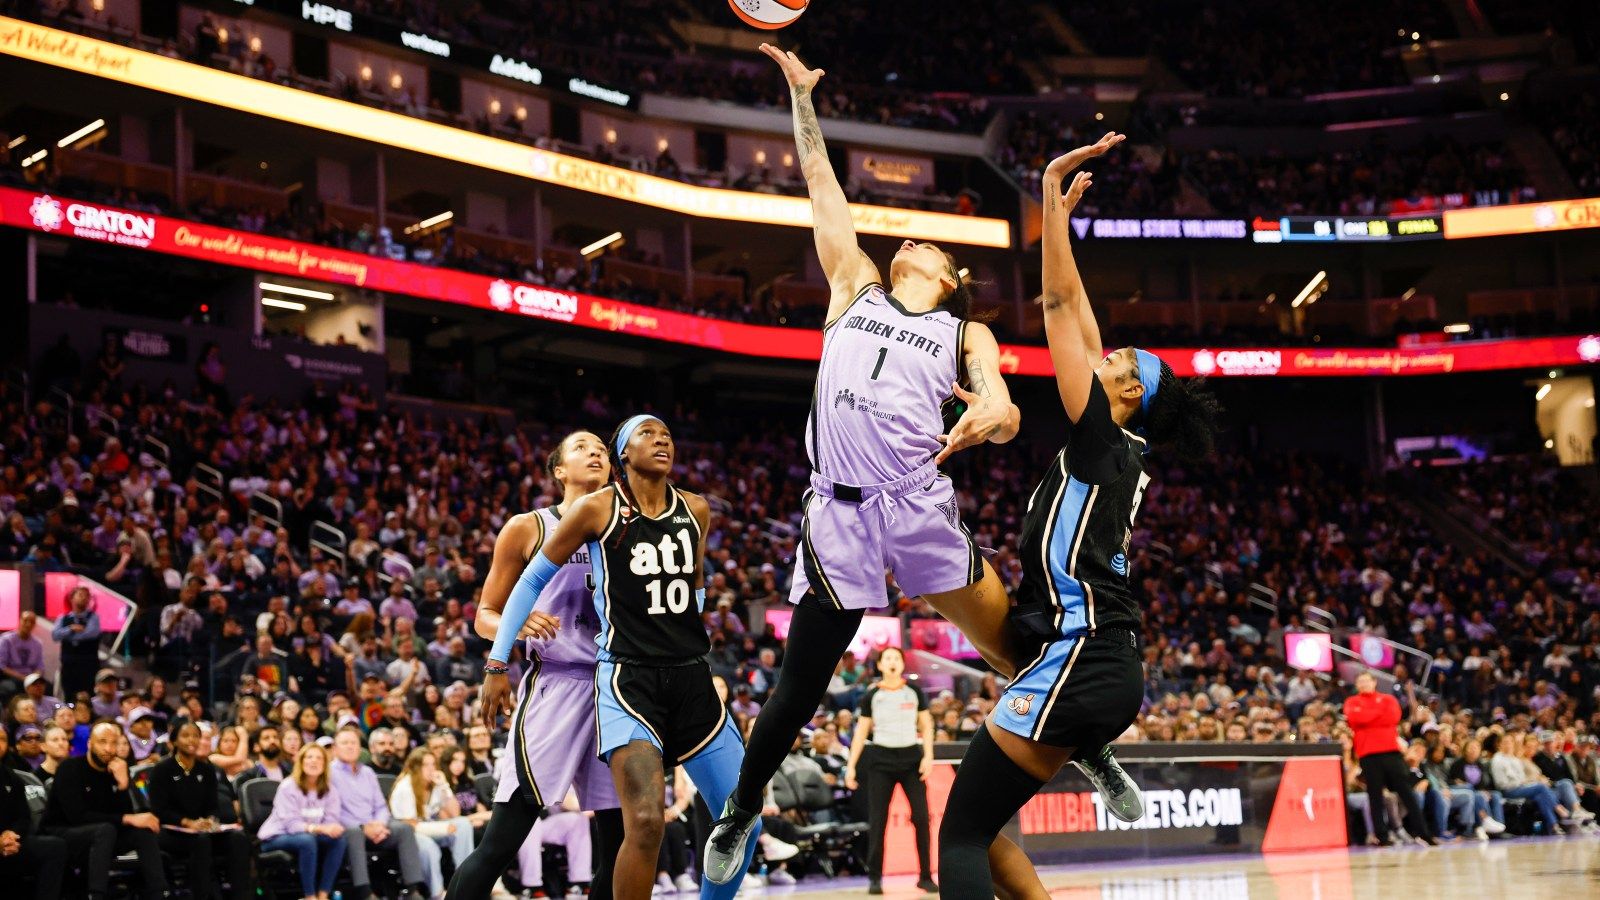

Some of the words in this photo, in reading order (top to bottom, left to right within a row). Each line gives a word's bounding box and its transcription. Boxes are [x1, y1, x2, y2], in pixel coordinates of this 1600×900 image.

[302, 0, 352, 31] HPE
[28, 32, 79, 57] World
[83, 47, 131, 72] Apart
[488, 54, 542, 85] Adobe
[554, 159, 636, 194] GRATON
[66, 204, 155, 240] GRATON
[1093, 219, 1141, 238] GOLDEN
[1141, 219, 1182, 238] STATE
[1181, 219, 1246, 239] VALKYRIES
[1397, 219, 1438, 235] FINAL
[175, 226, 201, 247] Our
[202, 234, 242, 255] world
[241, 245, 266, 261] was
[265, 246, 299, 266] made
[298, 249, 318, 274] for
[318, 258, 368, 286] winning
[514, 286, 577, 315] GRATON
[844, 315, 895, 339] GOLDEN
[896, 329, 942, 358] STATE
[870, 346, 888, 380] 1
[1216, 351, 1281, 369] GRATON
[1316, 351, 1348, 368] world
[630, 528, 694, 575] atl
[646, 579, 690, 614] 10
[1019, 787, 1243, 835] WNBATETS.COM
